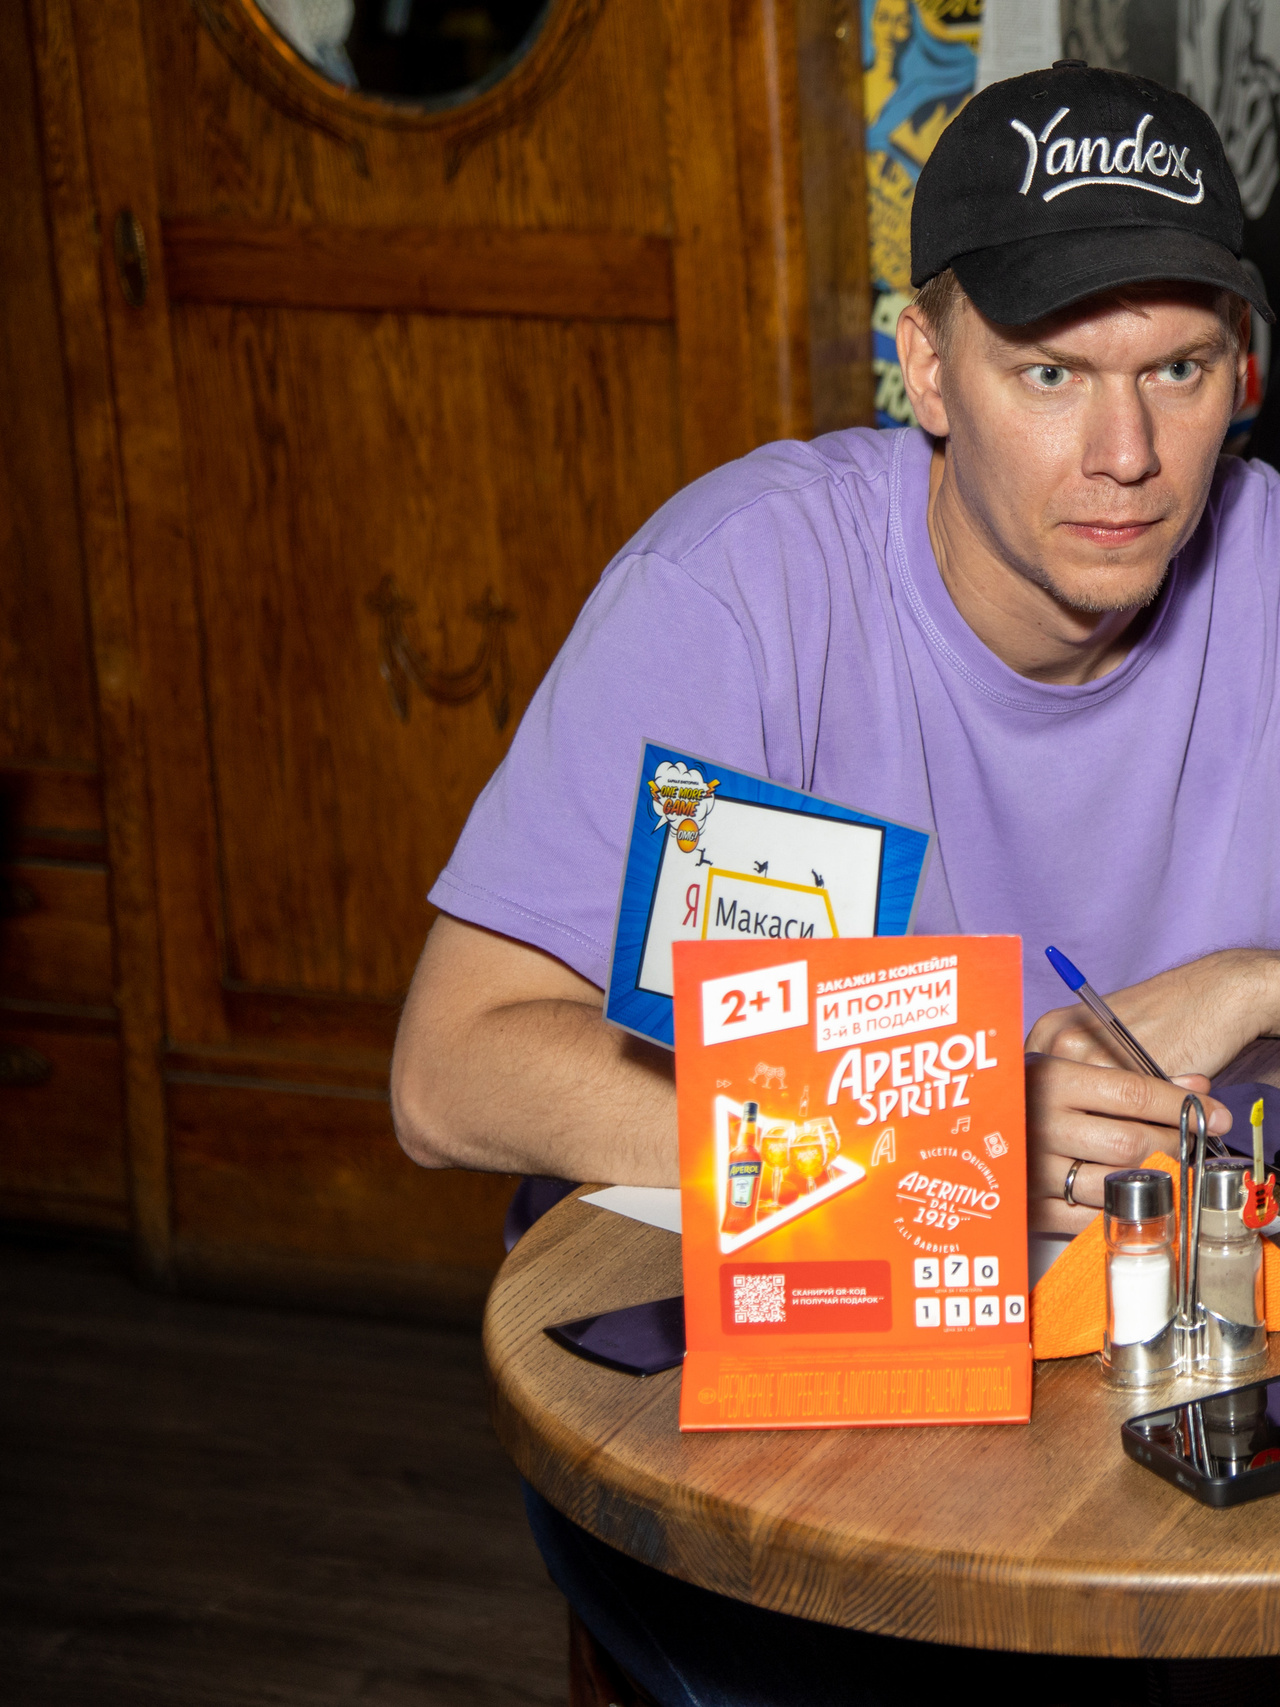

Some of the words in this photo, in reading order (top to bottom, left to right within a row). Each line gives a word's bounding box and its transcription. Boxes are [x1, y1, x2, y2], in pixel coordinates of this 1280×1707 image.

[1010, 107, 1204, 204] Yandex
[660, 785, 678, 798] ONE
[678, 787, 704, 800] MORE
[663, 798, 699, 817] GAME
[677, 830, 698, 842] OMG!
[816, 972, 876, 995] ЗАКАЖИ
[877, 969, 887, 982] 2
[888, 955, 958, 980] КОКТЕЙЛЯ
[720, 979, 791, 1026] 2+1
[823, 1002, 839, 1021] И
[847, 979, 951, 1016] ПОЛУЧИ
[852, 1022, 862, 1035] В
[866, 1003, 950, 1032] ПОДАРОК
[827, 1030, 998, 1106] APEROL
[730, 1164, 760, 1176] APEROL
[898, 1170, 1000, 1211] APERITIVO
[930, 1199, 955, 1213] DAL
[792, 1286, 834, 1296] СКАНИРУЙ
[835, 1287, 866, 1296] QR-КОД
[800, 1297, 838, 1305] ПОЛУЧАЙ
